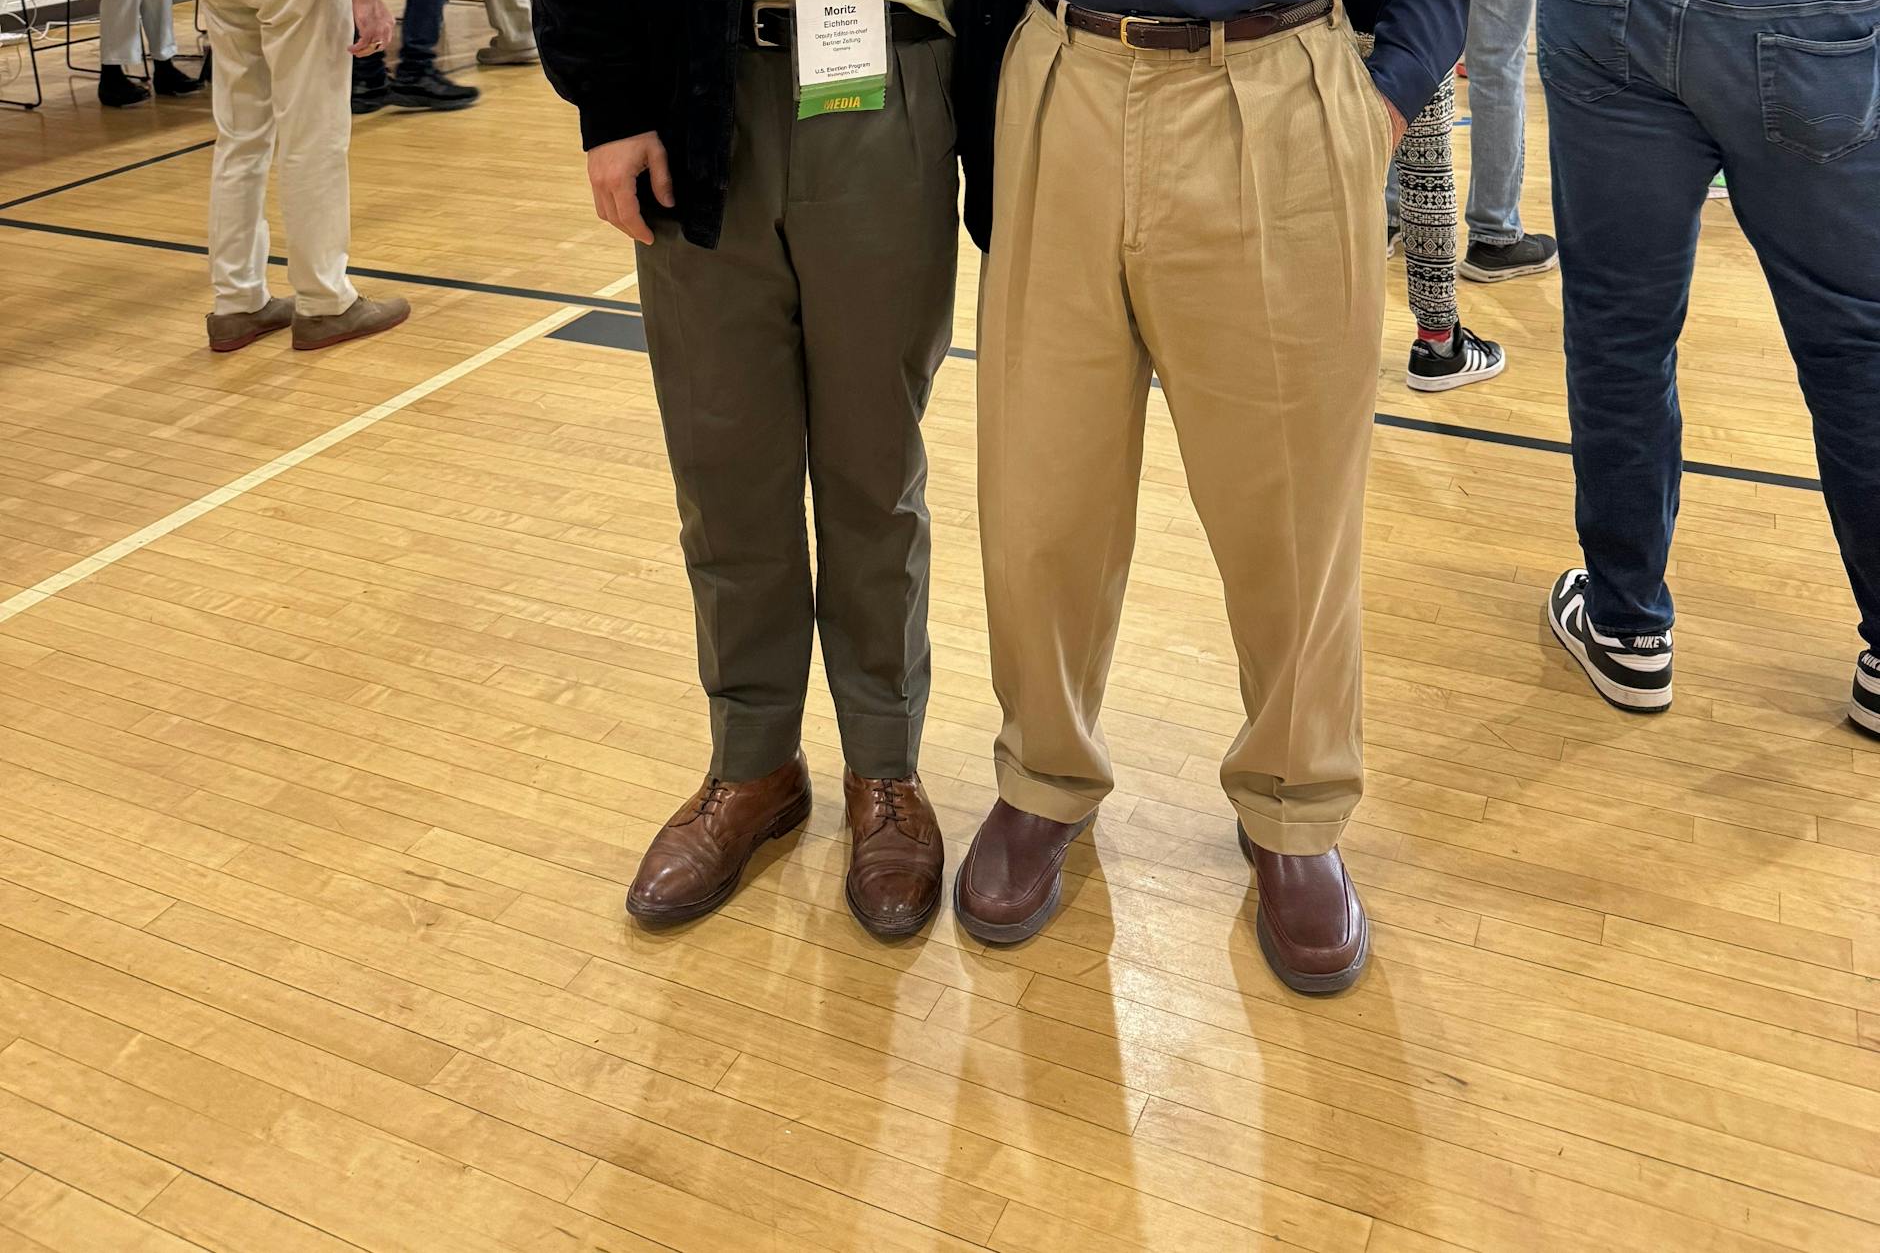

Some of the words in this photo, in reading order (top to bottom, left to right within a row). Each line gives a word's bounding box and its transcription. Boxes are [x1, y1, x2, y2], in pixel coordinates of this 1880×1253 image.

[824, 4, 857, 16] Moritz
[823, 19, 858, 29] Eichhorn
[826, 65, 848, 73] Election
[848, 61, 871, 69] Program
[823, 96, 861, 111] MEDIA
[1632, 635, 1660, 649] NIKE
[1860, 652, 1880, 672] NIK
